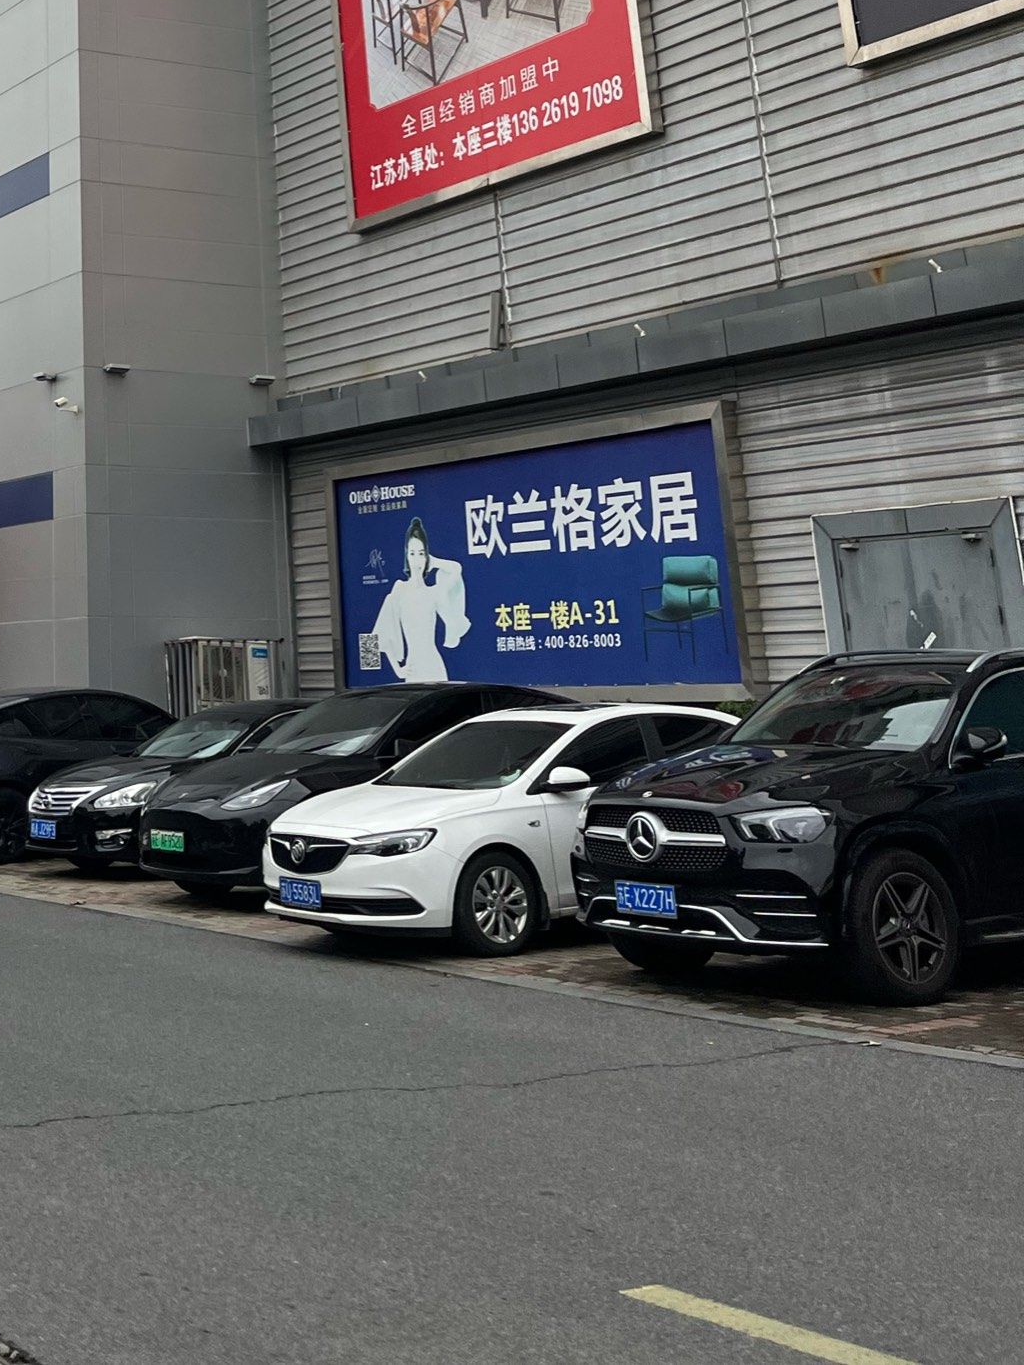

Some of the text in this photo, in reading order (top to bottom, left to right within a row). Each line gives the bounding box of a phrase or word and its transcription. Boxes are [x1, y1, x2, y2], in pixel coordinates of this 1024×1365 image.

[401, 56, 560, 140] 全国经销商加盟中
[542, 92, 579, 128] 2619
[583, 75, 624, 112] 7098
[380, 484, 416, 501] HOUSE
[464, 471, 699, 559] 欧兰格家居
[494, 599, 620, 632] 本座一楼A-31
